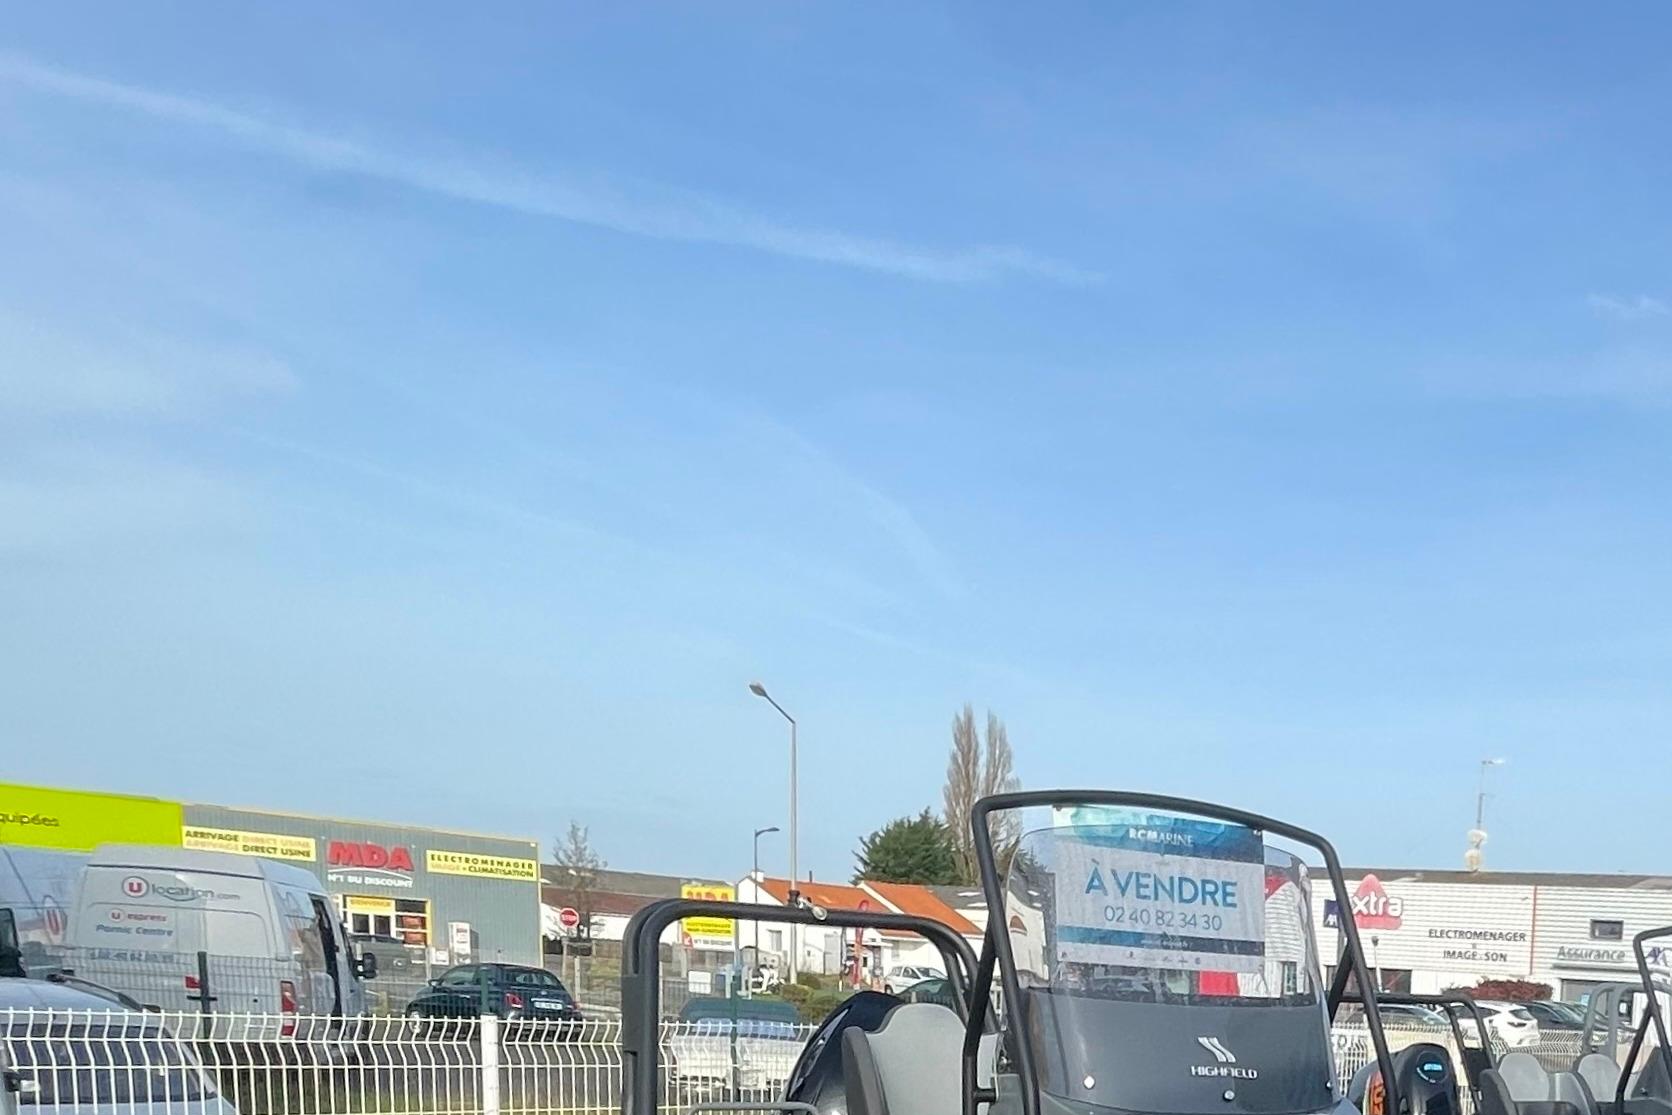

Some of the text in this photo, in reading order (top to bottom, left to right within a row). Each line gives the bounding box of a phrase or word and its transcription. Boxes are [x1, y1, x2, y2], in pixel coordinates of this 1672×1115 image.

[185, 830, 239, 842] ARRIVAGE
[1128, 828, 1194, 847] RCMARINE
[242, 844, 278, 854] DIRECT
[281, 849, 311, 857] USINE
[328, 841, 415, 872] MDA
[431, 854, 533, 870] ELECTROMENAGER
[468, 865, 534, 878] CLIMATISATION
[364, 876, 413, 888] DISCOUNT
[1085, 858, 1238, 908] À VENDRE
[1104, 905, 1222, 931] 02 40 82 34 30
[1429, 928, 1527, 942] ELECTROMENAGER
[1484, 951, 1508, 962] SON
[1557, 946, 1626, 962] Assurance
[1191, 1065, 1258, 1079] HIGHFIELD
